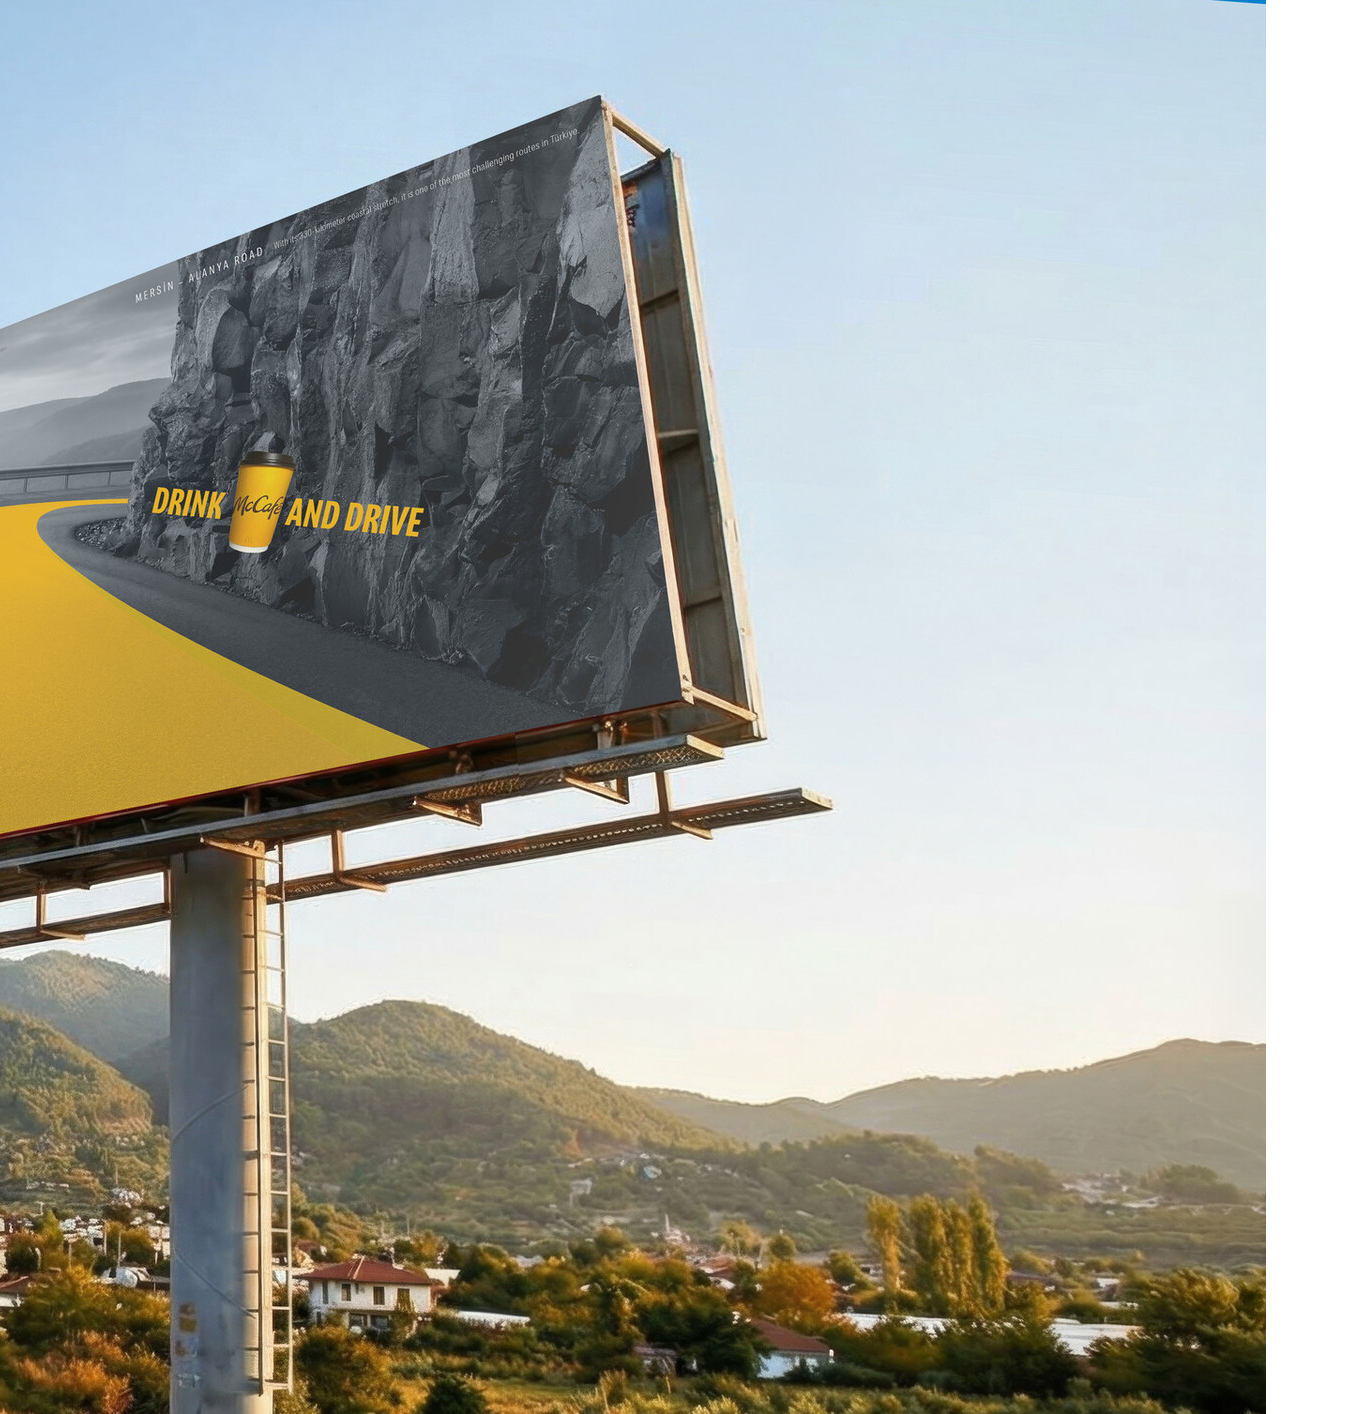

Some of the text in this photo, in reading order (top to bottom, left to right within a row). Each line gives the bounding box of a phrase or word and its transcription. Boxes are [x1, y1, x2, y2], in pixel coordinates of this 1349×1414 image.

[273, 238, 289, 250] With
[290, 234, 298, 244] its
[347, 205, 372, 221] coastal
[373, 197, 400, 212] stretch,
[401, 193, 407, 201] it
[408, 190, 414, 198] is
[415, 185, 429, 196] one
[430, 179, 438, 190] of
[438, 177, 451, 187] the
[452, 168, 471, 181] most
[471, 152, 515, 174] challenging
[516, 142, 540, 158] routes
[541, 139, 549, 148] in
[188, 260, 229, 283] ALANYA
[234, 247, 263, 266] ROAD
[152, 486, 425, 538] DRINK AND DRIVE
[234, 495, 284, 520] McCafé
